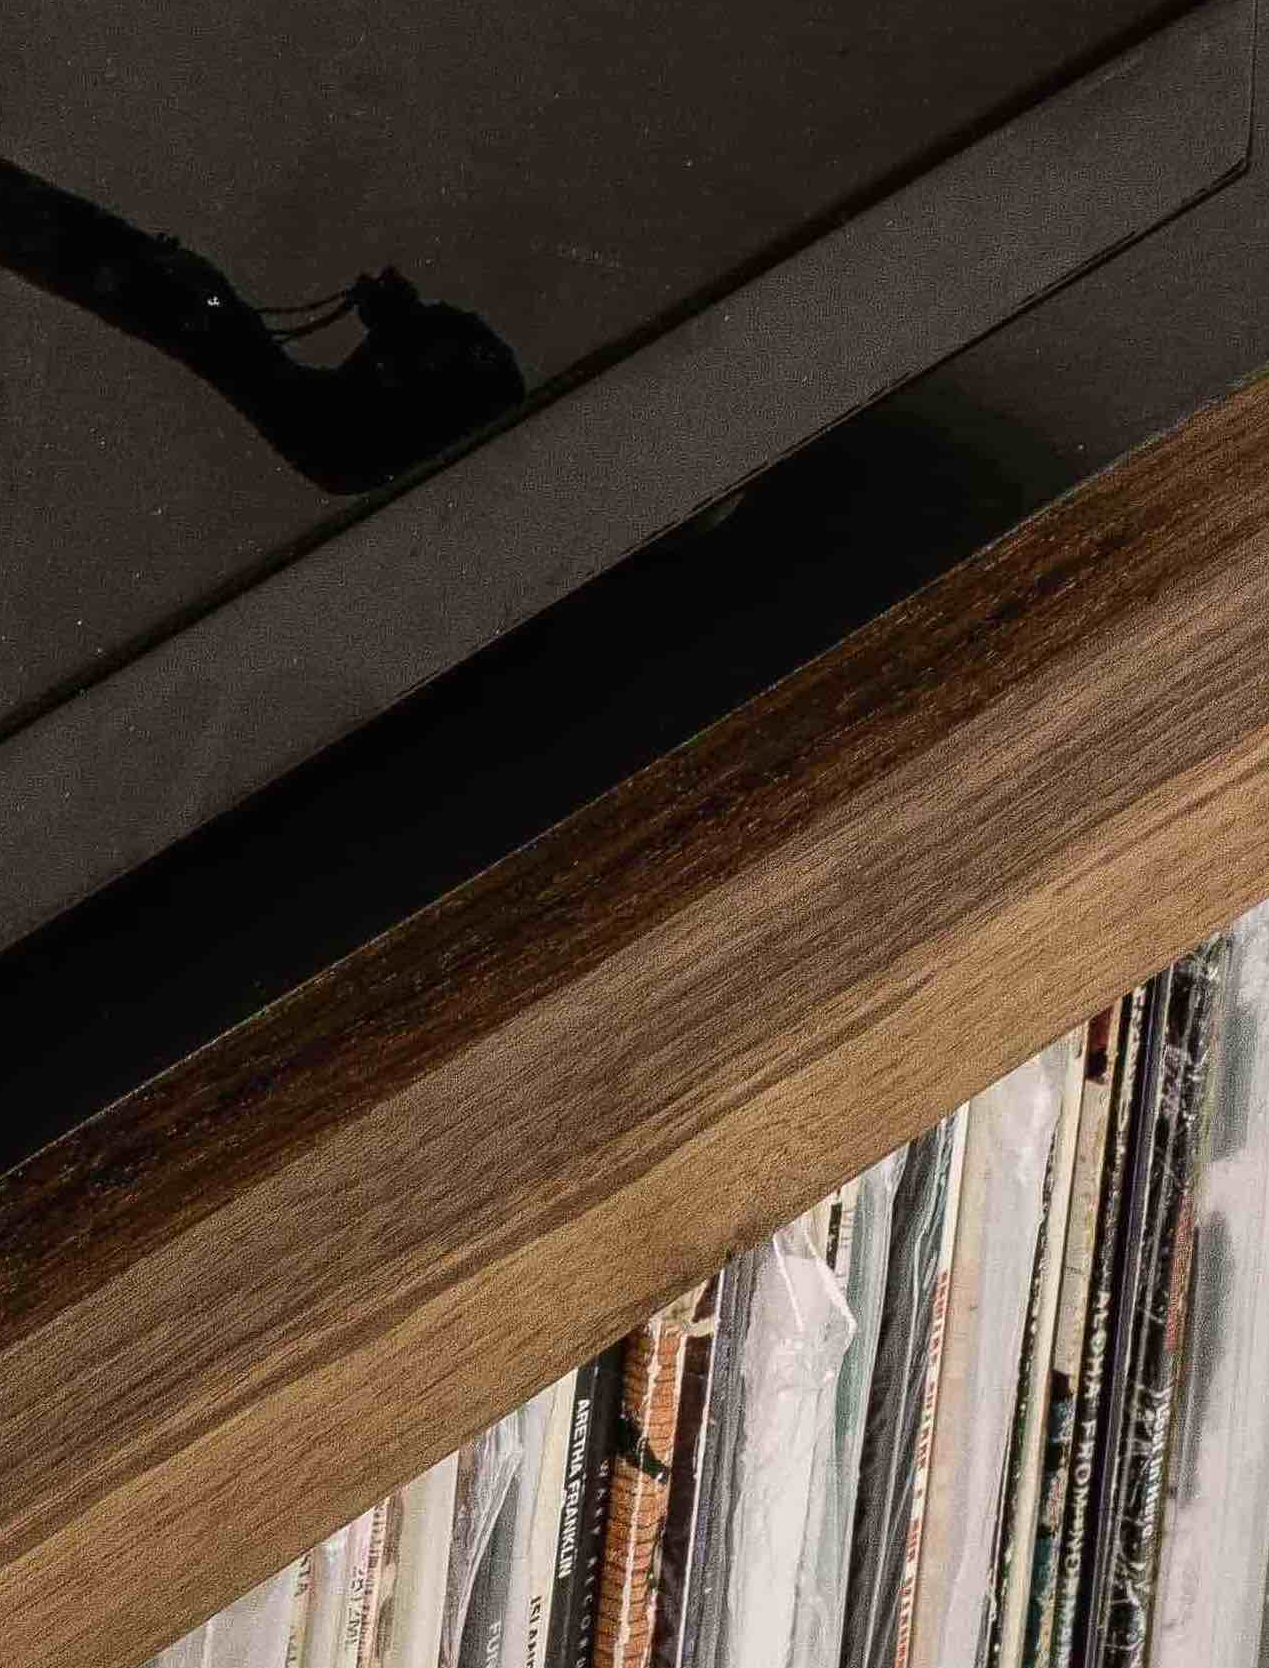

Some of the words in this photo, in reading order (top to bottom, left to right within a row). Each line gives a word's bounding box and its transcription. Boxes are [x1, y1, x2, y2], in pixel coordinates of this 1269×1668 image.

[567, 1397, 592, 1476] ARETHA
[1070, 1419, 1096, 1512] FROM
[555, 1480, 583, 1579] FRANKLIN
